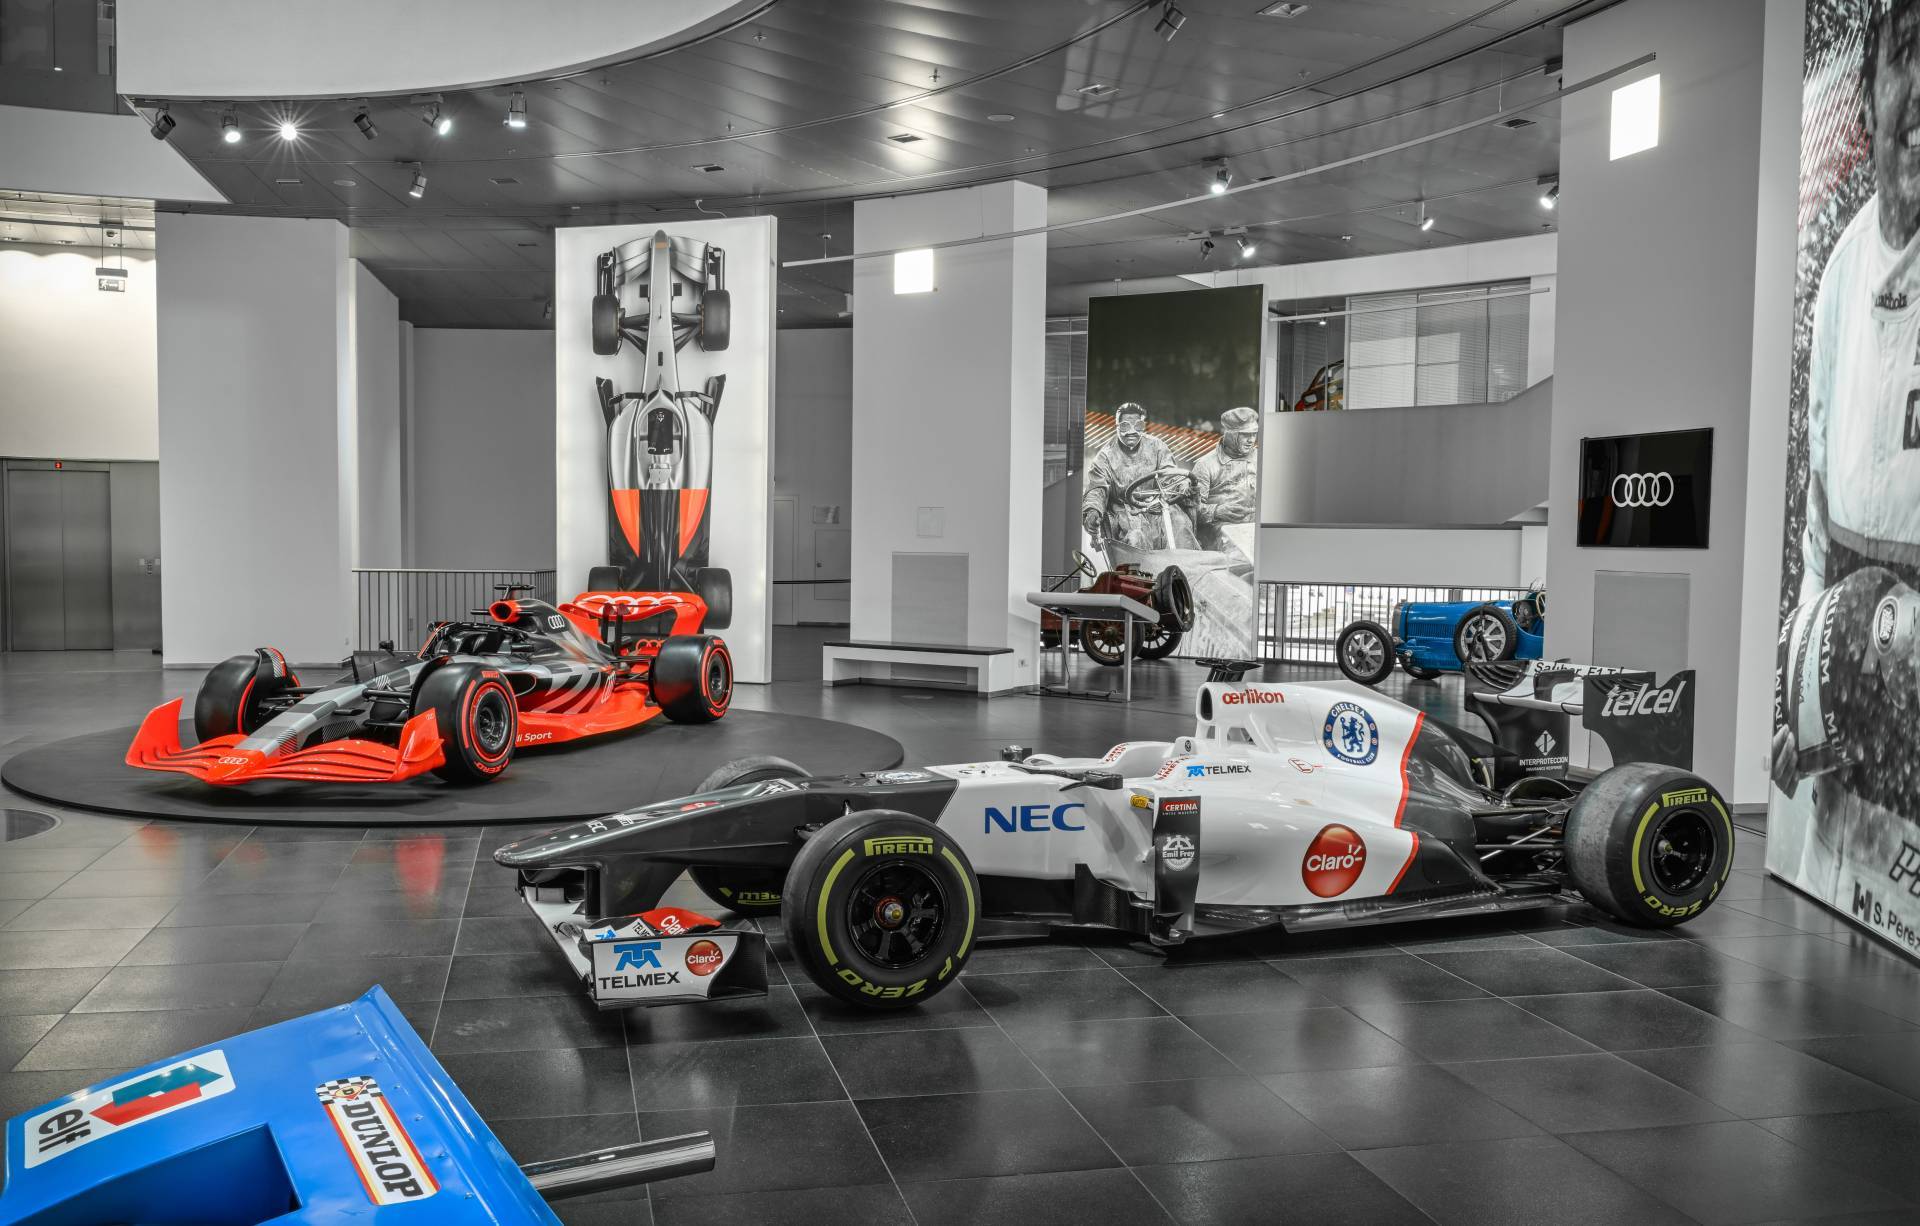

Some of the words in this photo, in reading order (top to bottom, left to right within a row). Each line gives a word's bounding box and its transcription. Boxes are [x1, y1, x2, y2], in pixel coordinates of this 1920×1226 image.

[1601, 680, 1687, 717] telcel
[1331, 703, 1365, 718] CHELSEA
[524, 731, 553, 743] Sport
[1205, 765, 1252, 776] TELMEX
[1165, 803, 1198, 812] CERTINA
[1662, 788, 1708, 808] PIRELLI
[984, 803, 1086, 834] NEC
[864, 836, 934, 857] PIRELLI
[1162, 850, 1178, 858] Emil
[1180, 849, 1195, 858] Frey
[1306, 852, 1355, 872] Claro
[1709, 881, 1719, 900] P
[1644, 895, 1703, 918] ZERO
[1873, 902, 1884, 928] S.
[687, 952, 715, 965] Claro
[938, 956, 952, 981] P
[598, 971, 681, 990] TELMEX
[836, 968, 928, 999] ZERO
[38, 1108, 92, 1153] elf
[342, 1099, 424, 1198] DUNLOP
